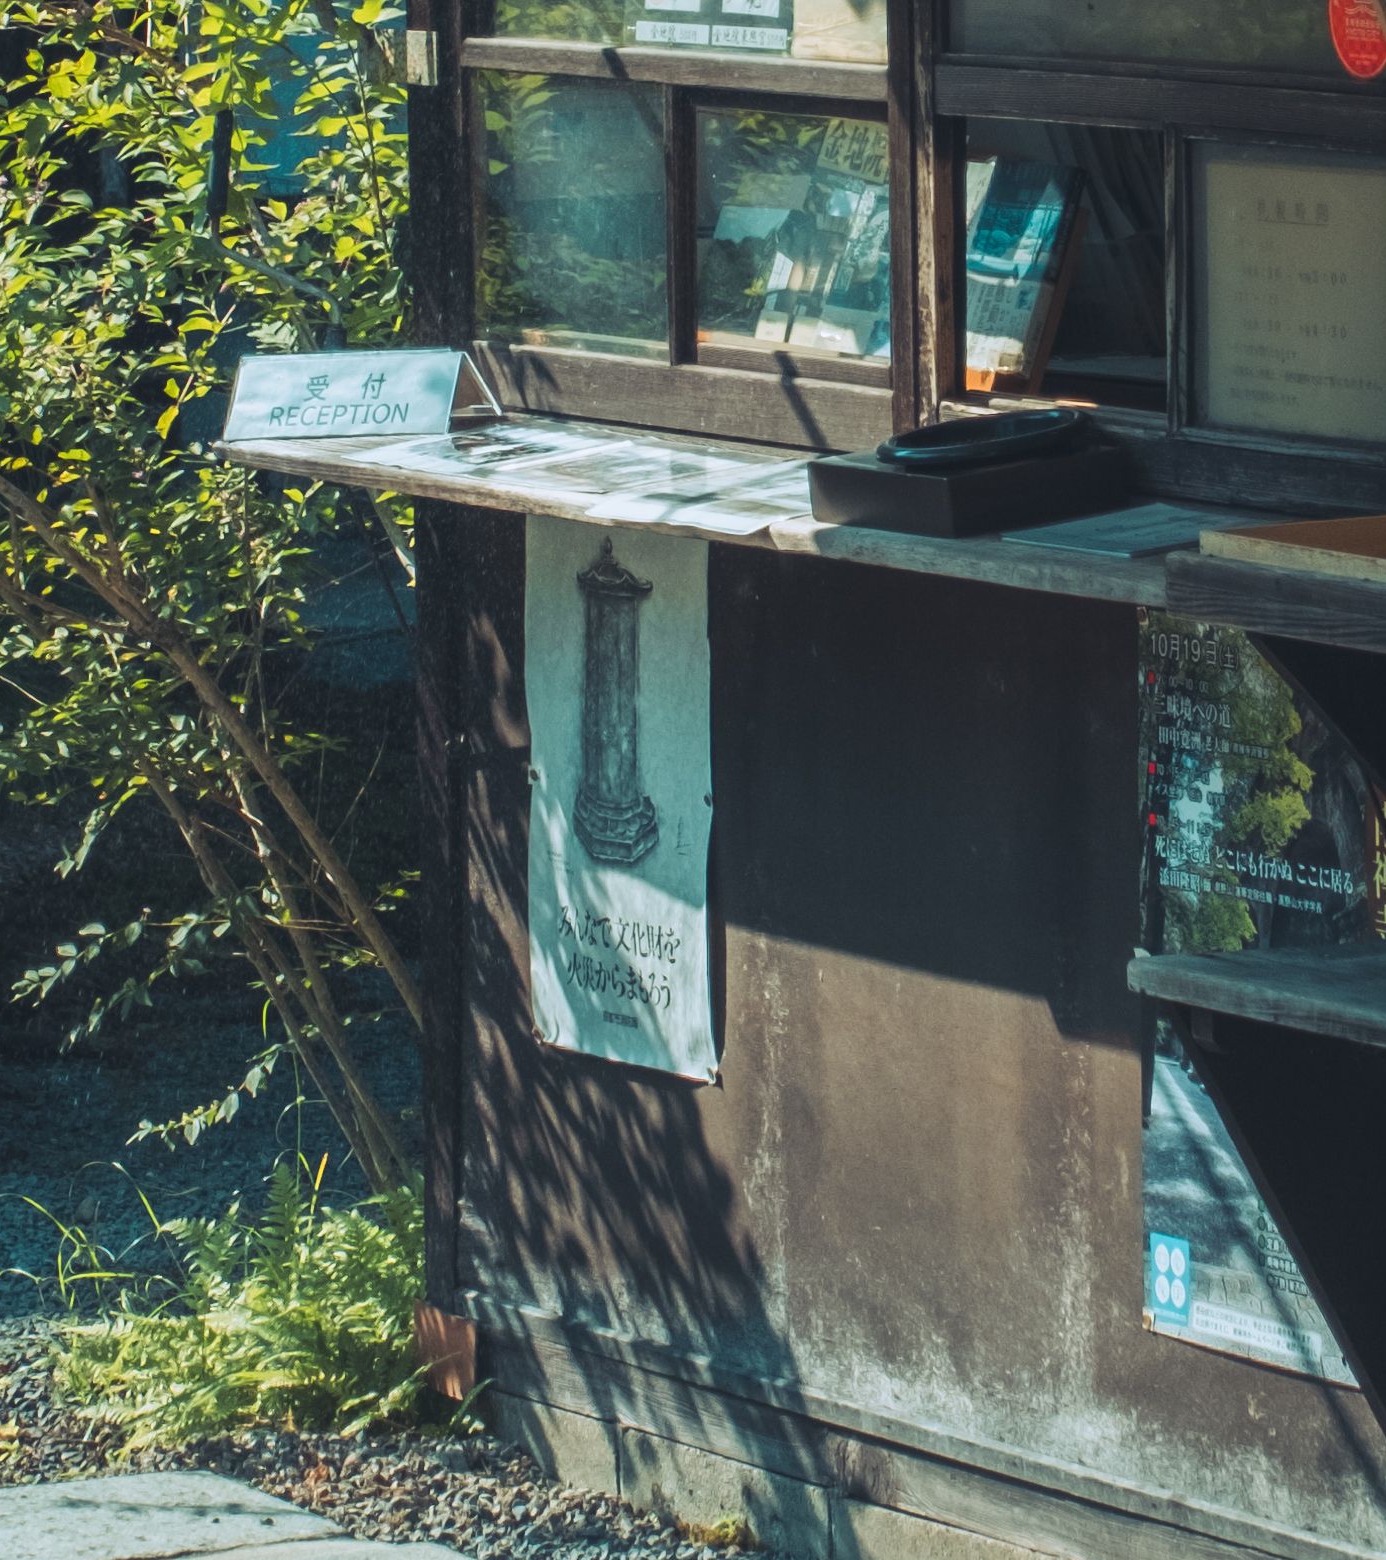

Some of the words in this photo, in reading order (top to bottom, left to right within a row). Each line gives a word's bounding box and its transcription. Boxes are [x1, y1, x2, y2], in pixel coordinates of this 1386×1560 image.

[303, 373, 387, 402] 受付
[268, 402, 410, 427] RECEPTION
[1155, 693, 1231, 729] 三昧境への道
[1215, 845, 1294, 883] どこにも行かぬ
[1296, 862, 1354, 896] ここに居る
[558, 906, 681, 964] みんなで文化財を
[566, 952, 671, 1009] 火災からまもろう
